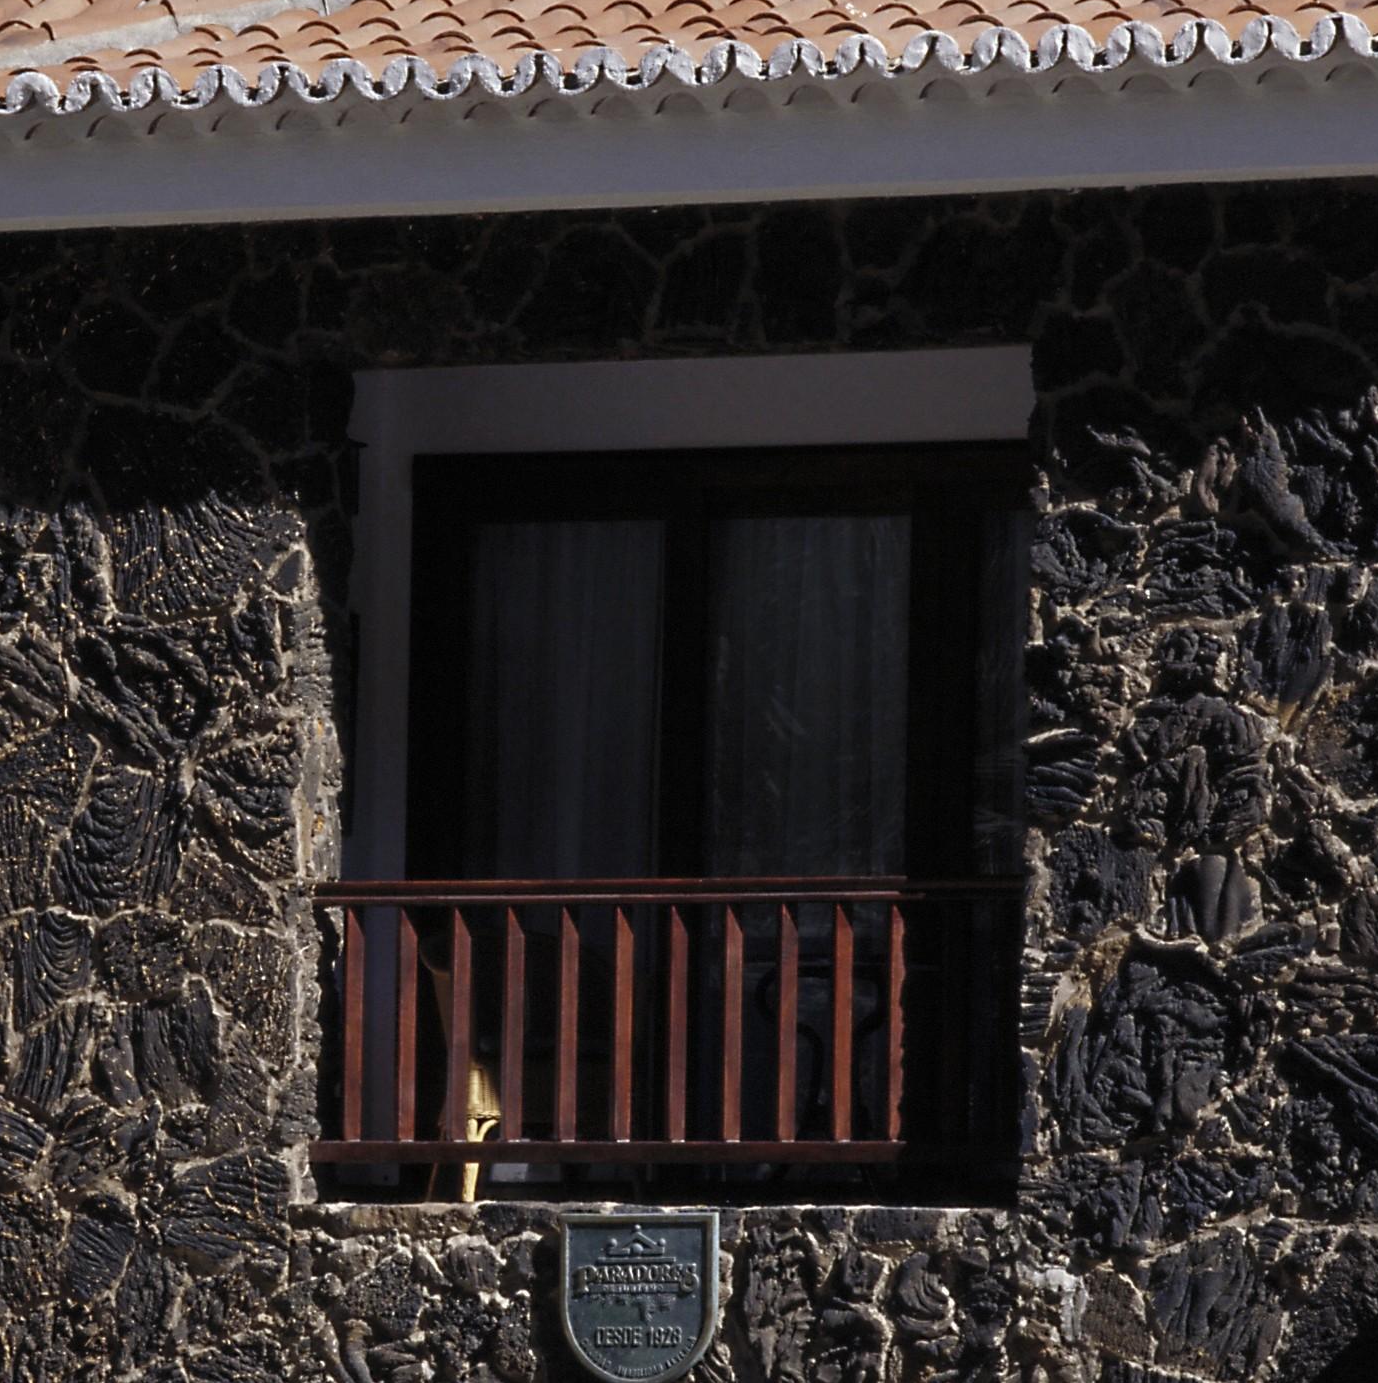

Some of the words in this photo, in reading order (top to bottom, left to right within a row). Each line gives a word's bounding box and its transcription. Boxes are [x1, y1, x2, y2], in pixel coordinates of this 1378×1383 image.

[572, 1262, 700, 1295] PARADORES
[596, 1325, 643, 1346] DESDE
[648, 1325, 683, 1346] 1928
